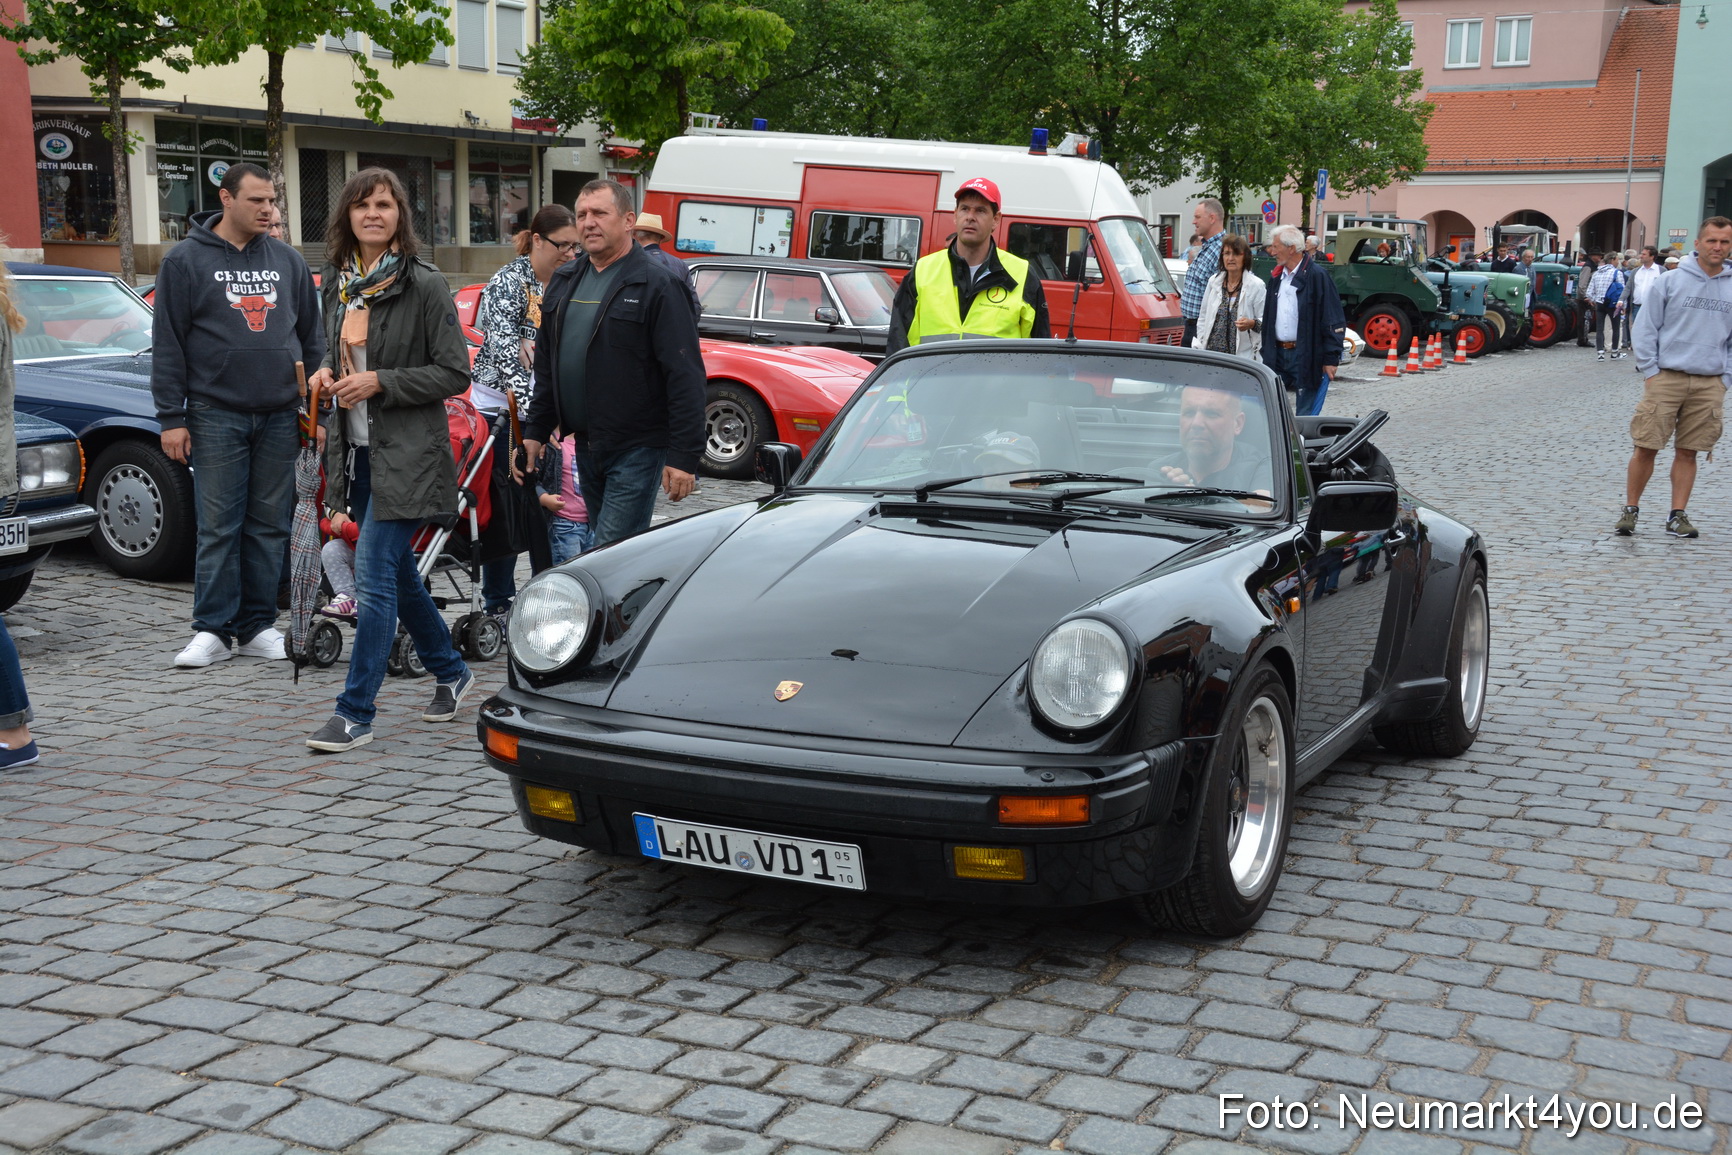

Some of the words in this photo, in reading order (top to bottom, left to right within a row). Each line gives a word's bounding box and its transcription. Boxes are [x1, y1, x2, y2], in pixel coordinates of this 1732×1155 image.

[200, 138, 239, 153] FABRIKVERKAUF
[242, 149, 262, 157] ELSBETH
[60, 162, 94, 171] MÜLLER
[157, 162, 178, 171] Kräuter
[182, 164, 195, 172] Tees
[165, 172, 188, 180] Gewürze
[1318, 173, 1326, 197] P
[213, 269, 281, 283] CHICAGO
[231, 282, 271, 295] BULLS
[645, 839, 654, 851] D
[656, 824, 731, 866] LAU
[834, 850, 851, 862] 05
[839, 873, 854, 885] 10
